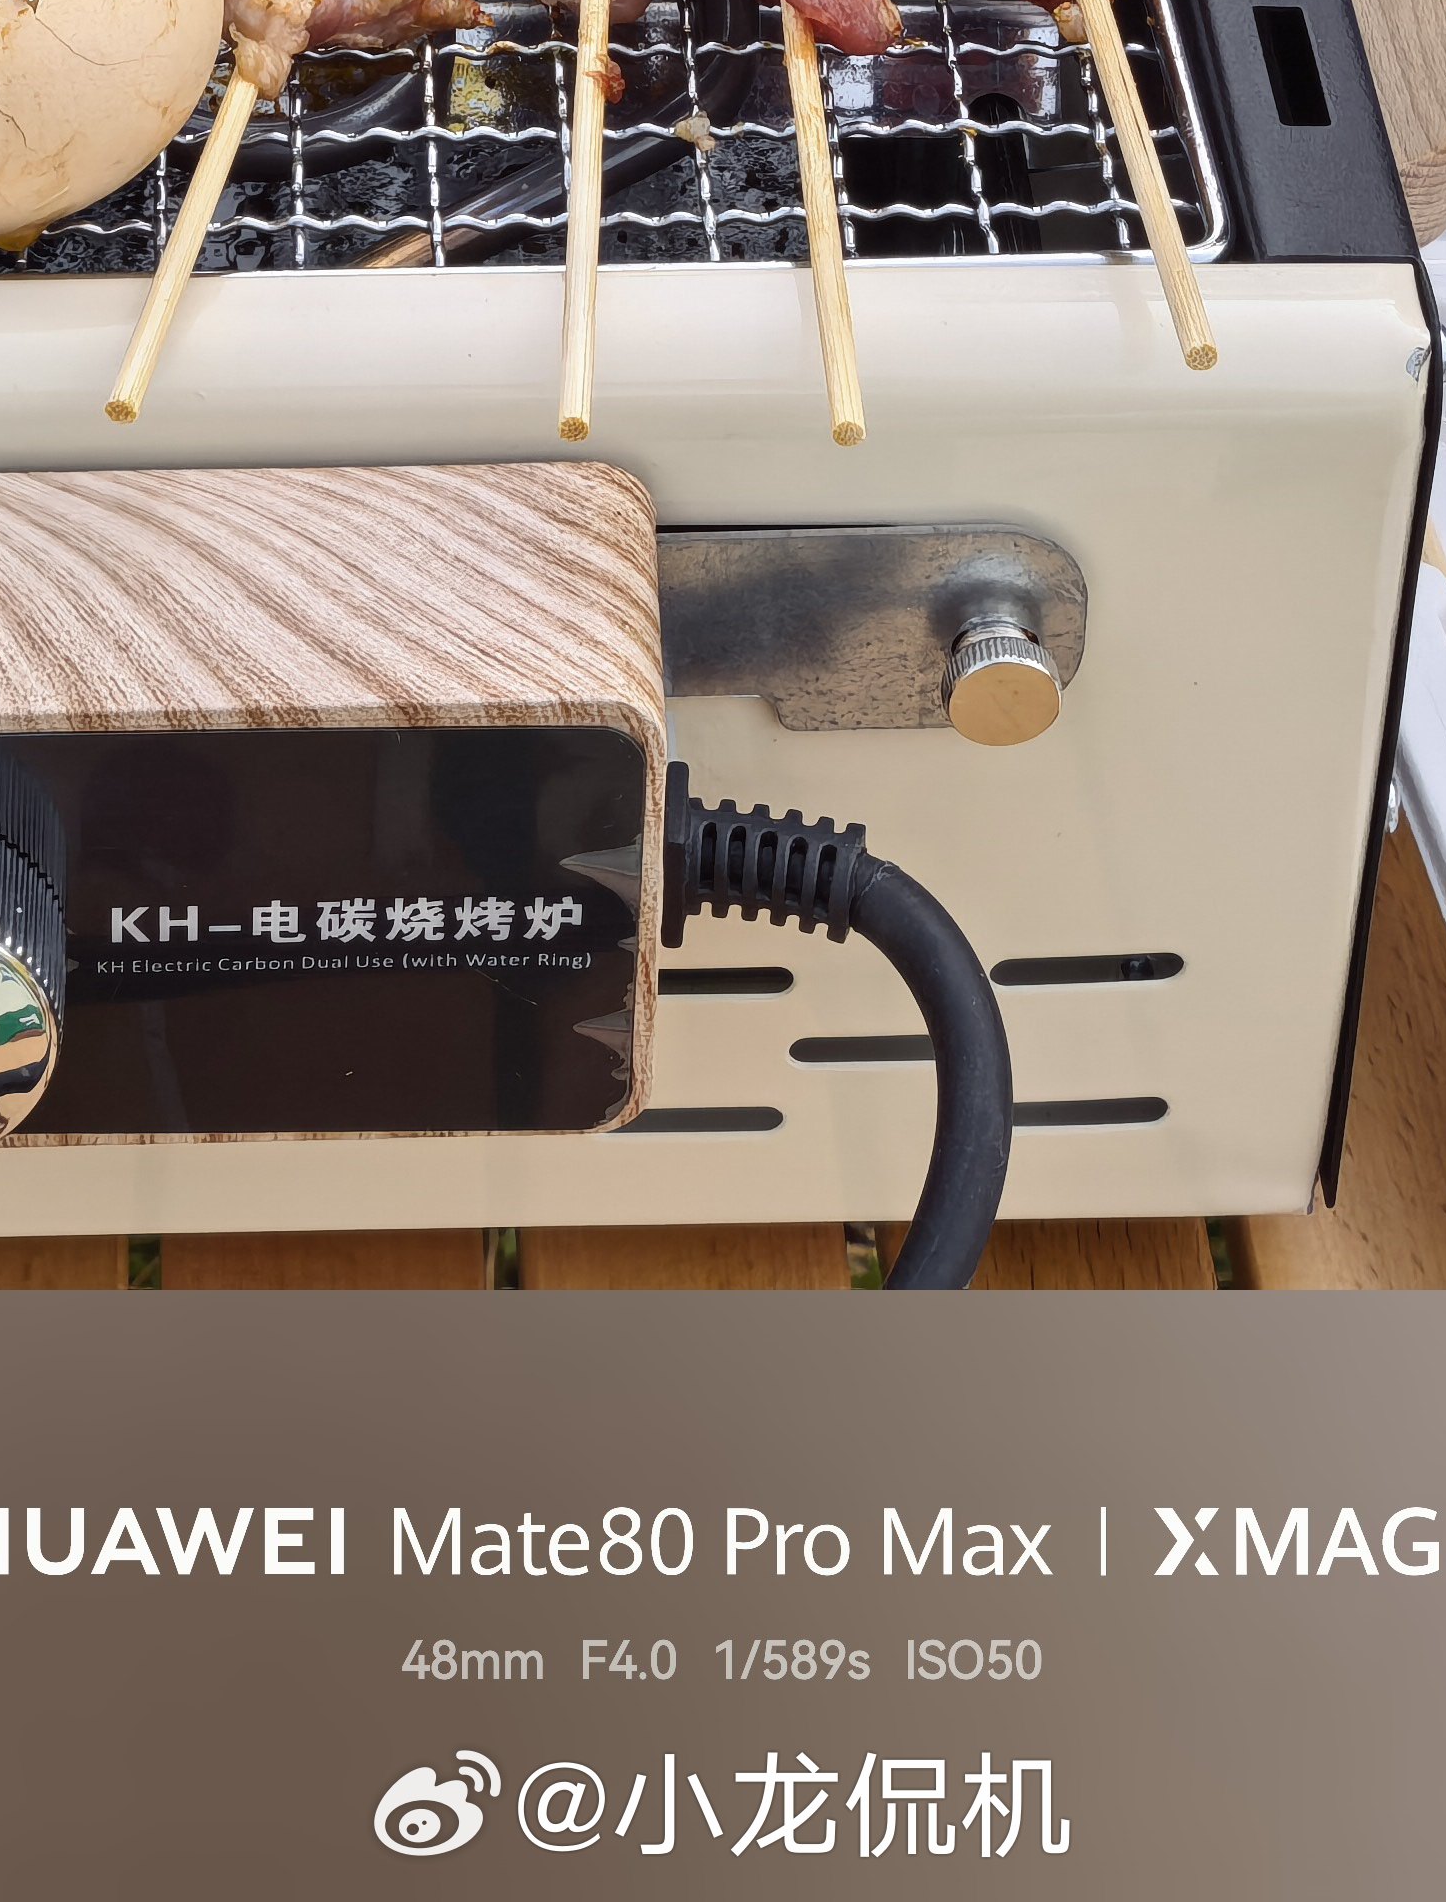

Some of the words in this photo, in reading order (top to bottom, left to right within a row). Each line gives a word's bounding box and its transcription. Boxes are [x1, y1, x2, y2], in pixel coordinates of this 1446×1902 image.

[97, 961, 125, 974] KH
[132, 958, 212, 973] Electric
[218, 956, 294, 971] Carbon
[302, 955, 348, 970] Dual
[356, 955, 394, 968] Use
[402, 953, 457, 969] (with
[465, 953, 530, 967] Water
[538, 952, 592, 970] Ring)
